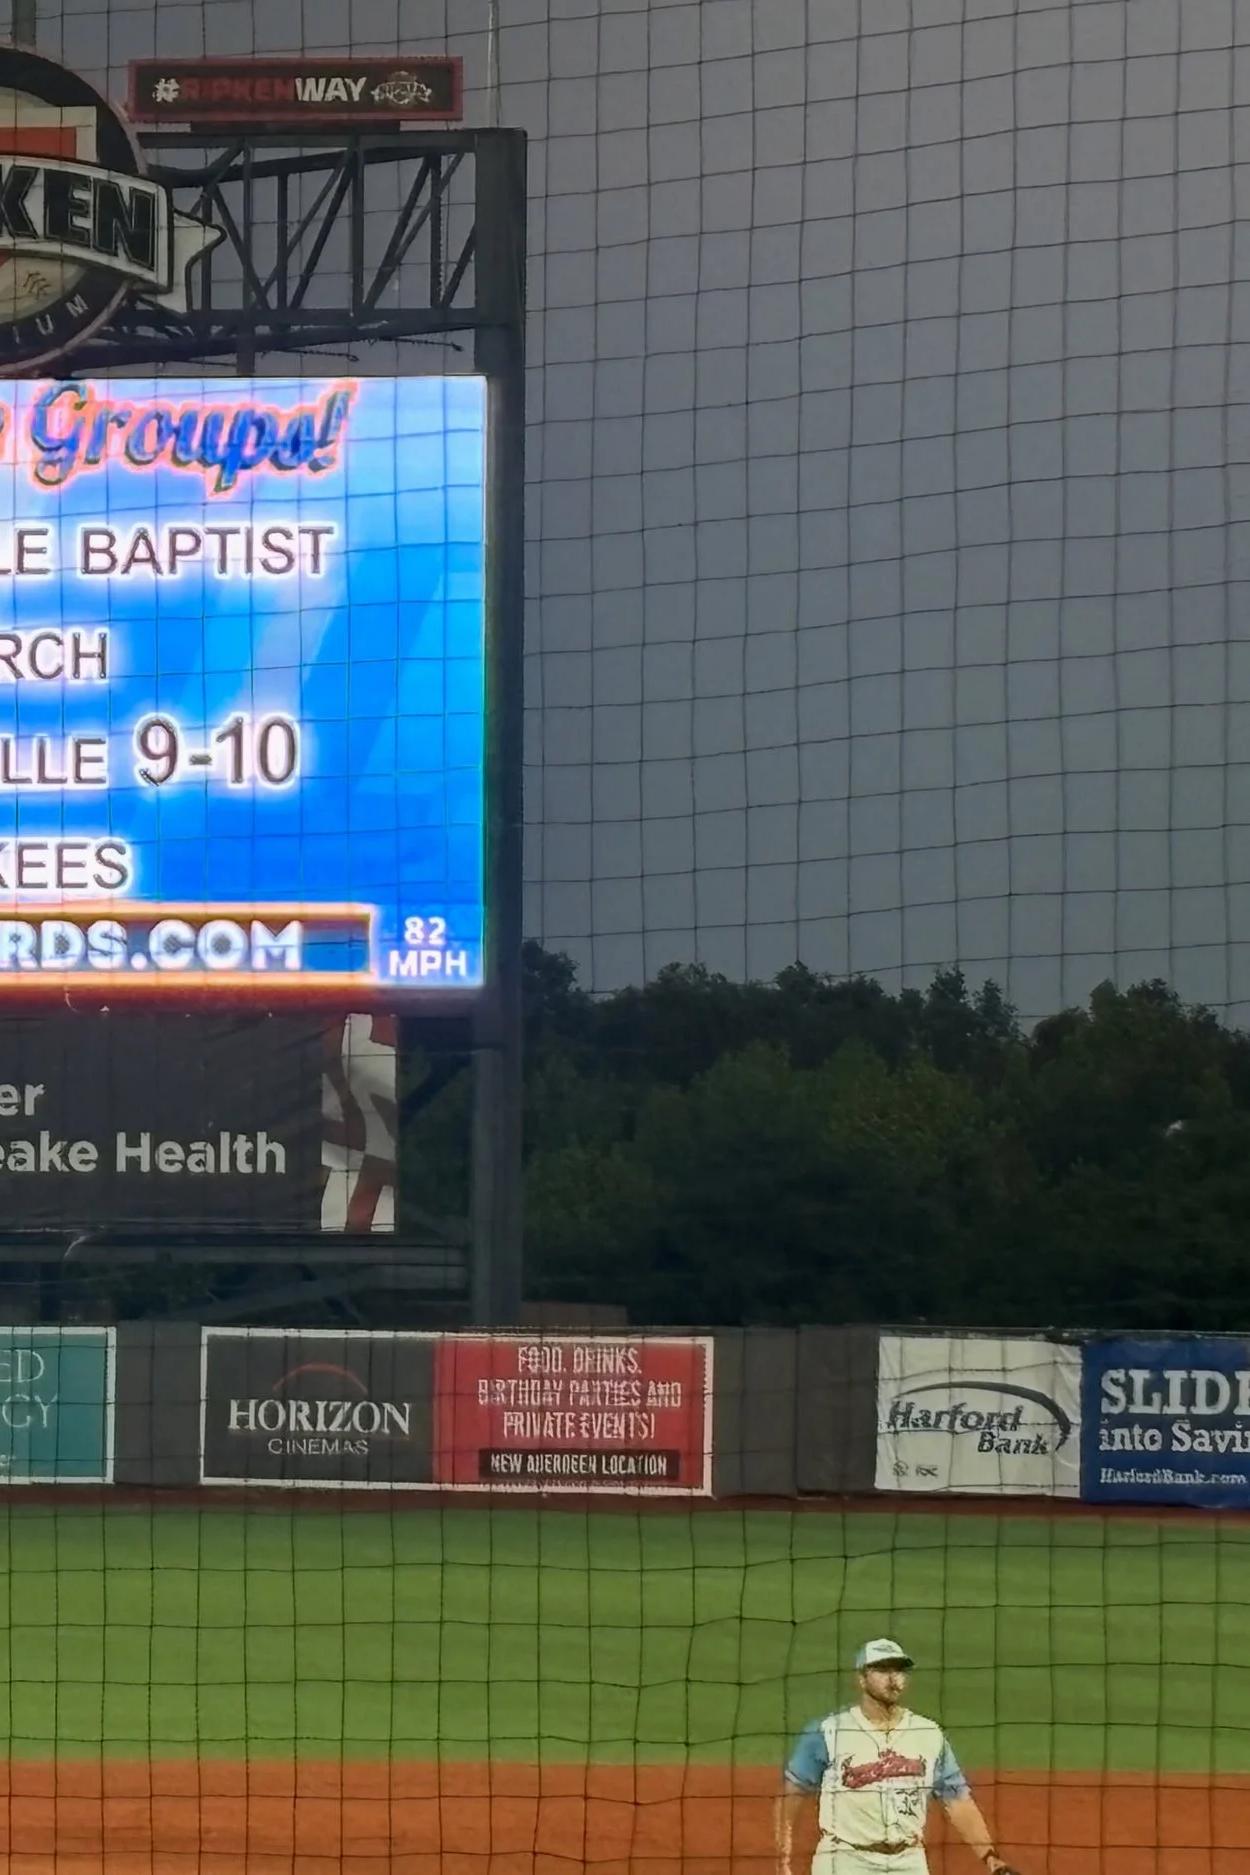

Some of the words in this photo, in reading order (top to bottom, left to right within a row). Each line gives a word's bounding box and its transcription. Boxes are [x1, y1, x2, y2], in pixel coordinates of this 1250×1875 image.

[30, 380, 353, 494] Groups!
[77, 526, 336, 576] BAPTIST
[135, 713, 299, 787] 9-10
[403, 916, 447, 946] 82
[388, 949, 468, 978] MPH
[114, 1131, 287, 1175] Health
[478, 1379, 563, 1406] BIRTHDAY
[569, 1380, 642, 1407] PARTIES
[646, 1381, 682, 1408] AND
[227, 1399, 412, 1435] HORIZON
[503, 1411, 575, 1439] PRIVATE
[887, 1401, 1024, 1433] Harford
[268, 1438, 370, 1456] CINEMAS
[977, 1432, 1051, 1455] Bank
[1099, 1419, 1162, 1452] into
[491, 1454, 522, 1473] NEW
[527, 1454, 597, 1474] ABERDEEN
[602, 1454, 668, 1476] LOCATION
[1100, 1468, 1247, 1484] HarfordBank.com
